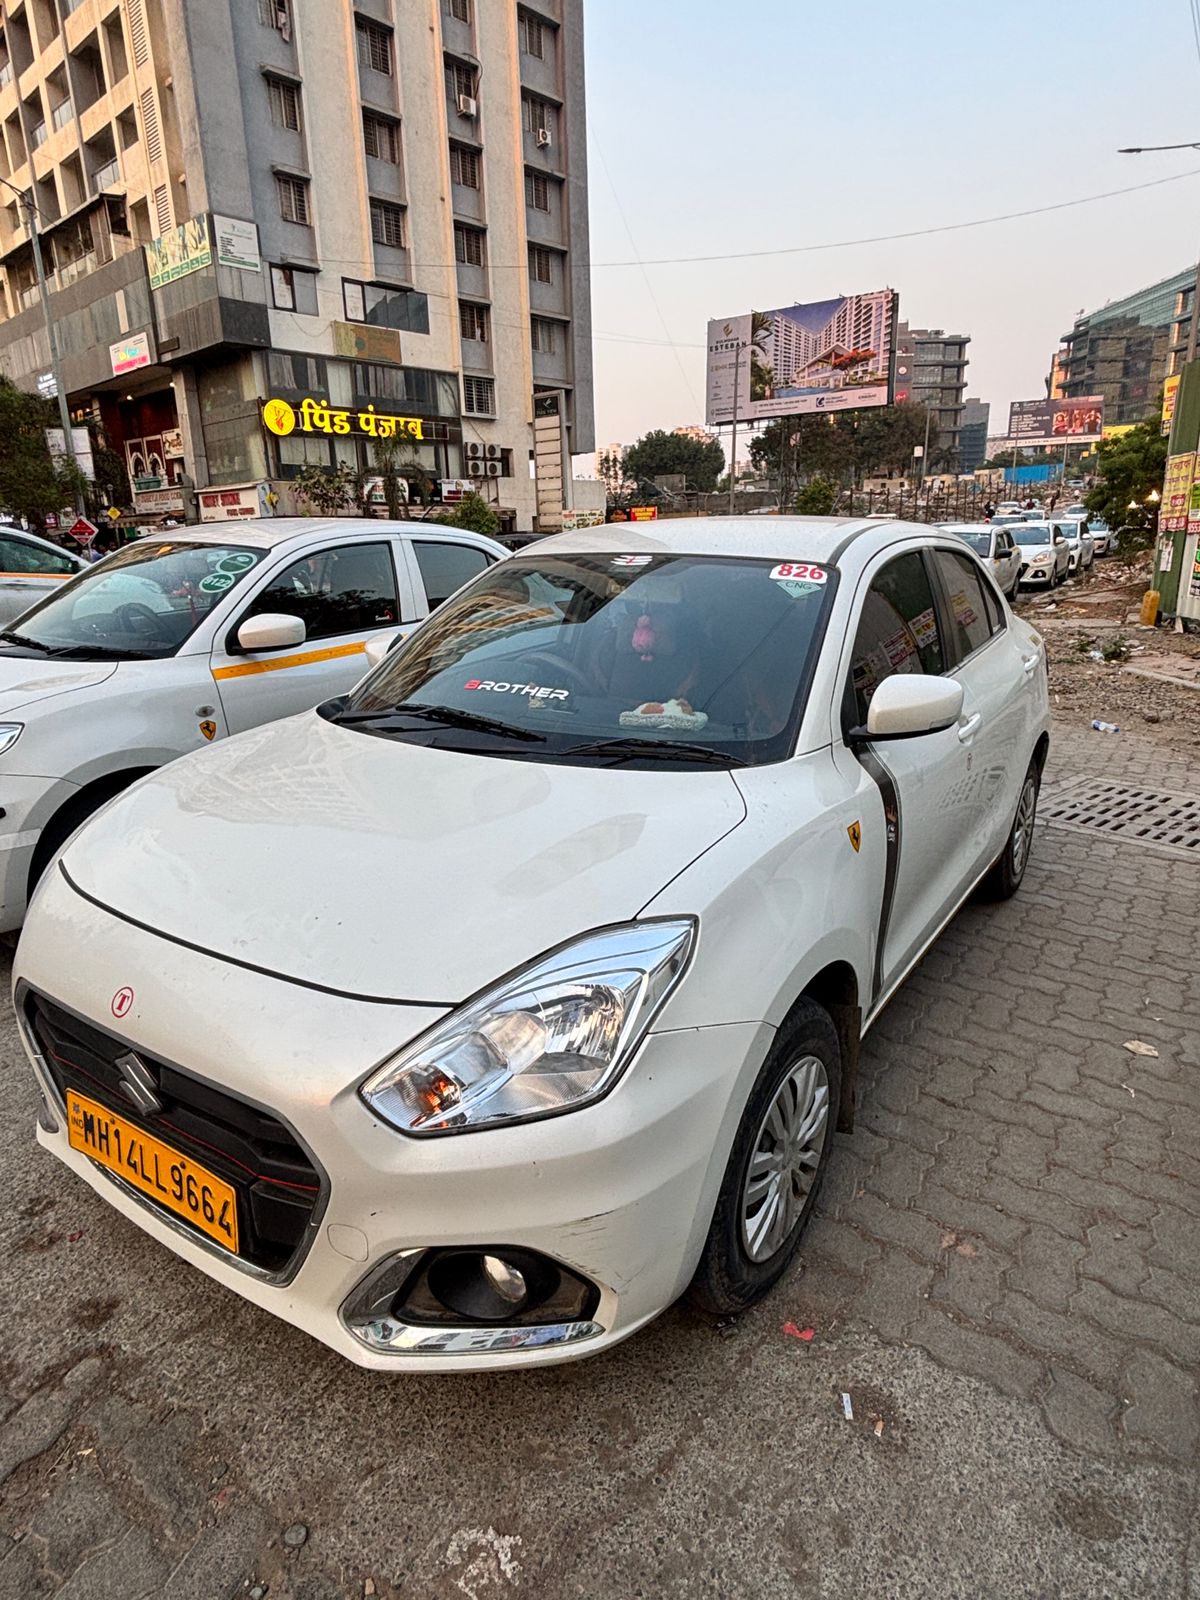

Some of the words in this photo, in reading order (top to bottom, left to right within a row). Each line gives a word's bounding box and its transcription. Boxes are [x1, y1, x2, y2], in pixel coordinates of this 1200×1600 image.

[709, 341, 746, 352] ESTEBAN
[300, 398, 350, 434] पिंड
[357, 404, 424, 440] पंजाब
[778, 564, 823, 580] 826
[785, 581, 812, 590] CNG
[463, 679, 570, 700] BROTHER
[71, 1116, 84, 1130] IND
[82, 1110, 233, 1238] MH14LL9664
